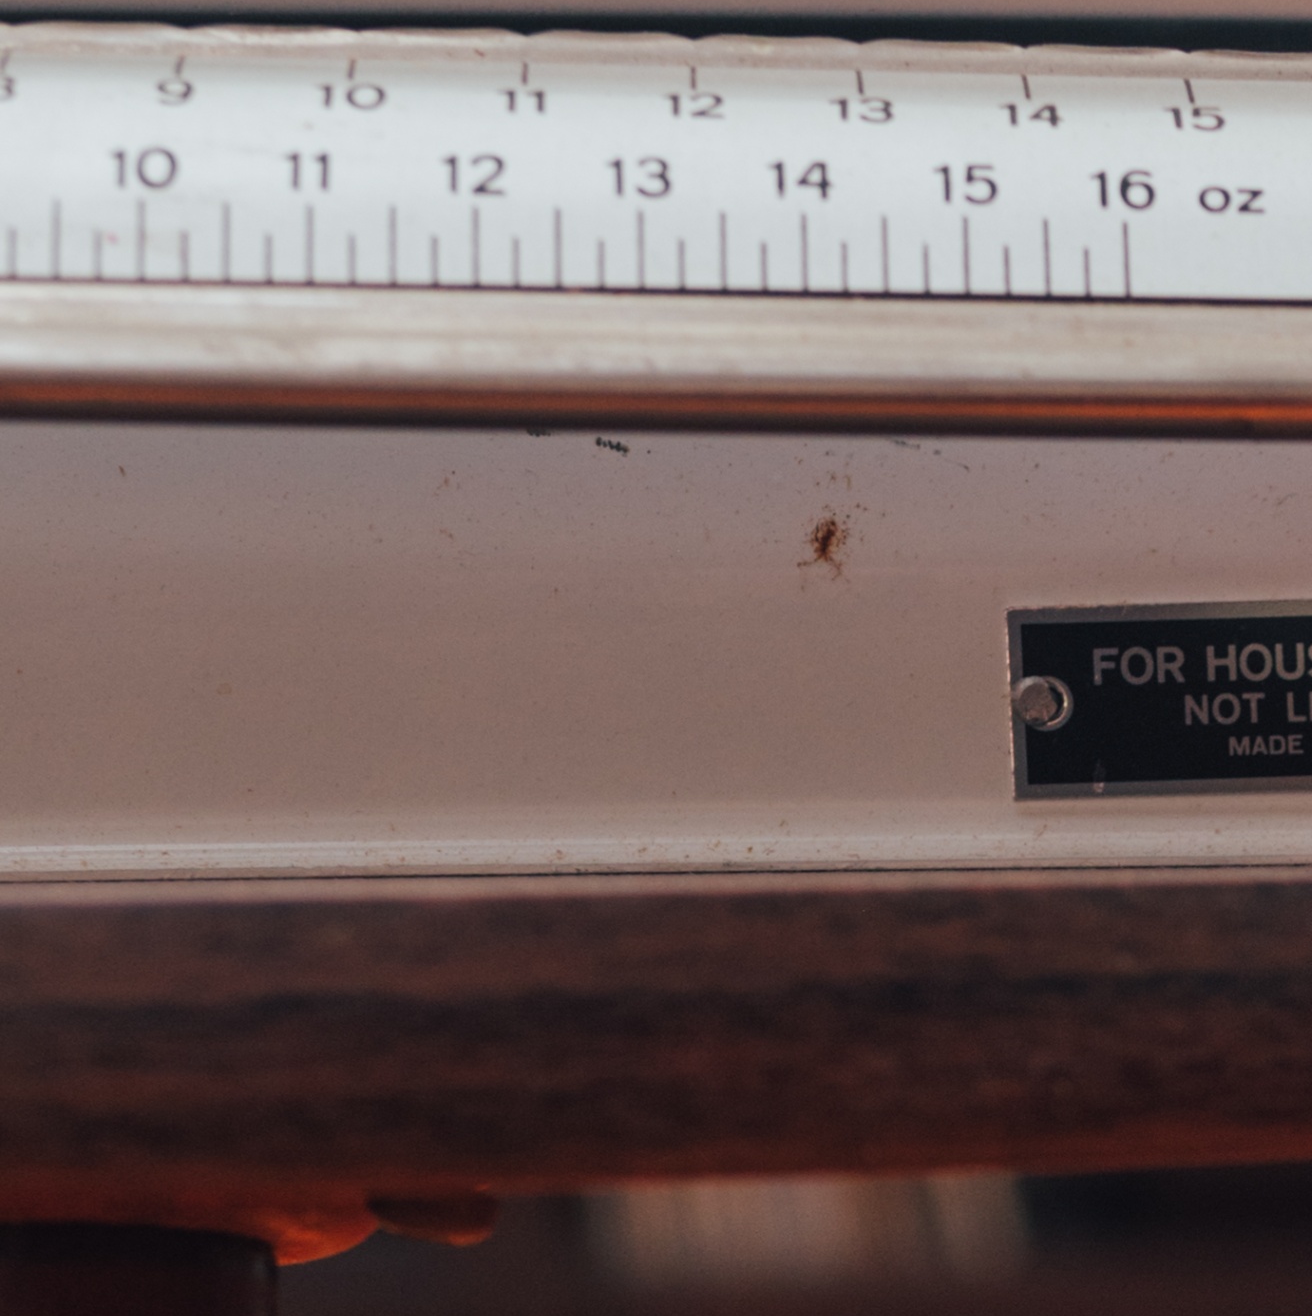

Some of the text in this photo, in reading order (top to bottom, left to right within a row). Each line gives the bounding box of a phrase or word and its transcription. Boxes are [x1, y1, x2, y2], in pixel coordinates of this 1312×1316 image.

[156, 79, 194, 105] 9
[316, 83, 387, 109] 10
[500, 88, 546, 113] 11
[663, 93, 724, 117] 12
[830, 97, 894, 122] 13
[1001, 103, 1060, 127] 14
[1164, 105, 1226, 131] 15
[109, 147, 1263, 213] 10 11 12 13 14 15 16 oz
[1092, 646, 1186, 686] FOR
[1184, 692, 1266, 726] NOT
[1228, 734, 1304, 757] MADE
